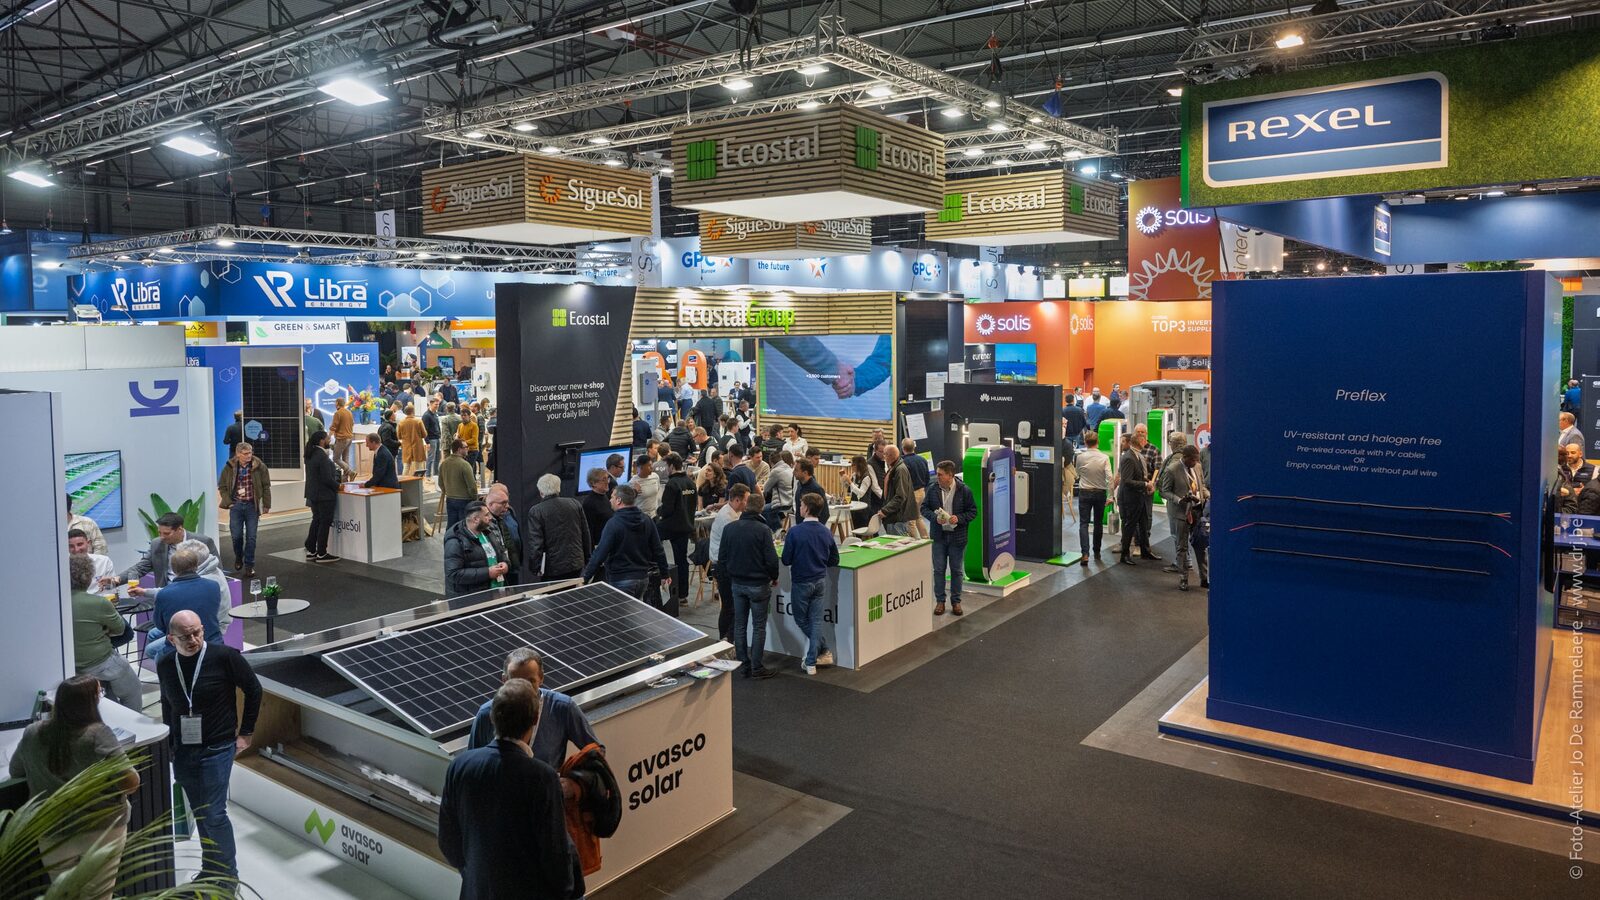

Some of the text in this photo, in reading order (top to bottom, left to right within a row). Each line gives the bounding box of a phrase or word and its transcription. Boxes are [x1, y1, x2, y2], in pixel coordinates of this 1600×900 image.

[721, 126, 820, 169] Ecostal
[880, 134, 939, 177] Ecostal
[449, 175, 513, 212] SigueSol
[567, 179, 643, 211] SigueSol
[967, 185, 1047, 216] Ecostal
[1084, 188, 1117, 215] Ecostal
[821, 217, 867, 239] SigueSol
[681, 252, 716, 268] GPC
[757, 261, 790, 271] the future
[911, 262, 932, 276] GPC
[130, 281, 160, 303] Libra
[304, 278, 368, 300] Libra
[274, 323, 303, 331] GREEN
[313, 322, 341, 331] SMART
[569, 311, 610, 326] Ecostal
[997, 314, 1032, 331] solis
[1080, 314, 1094, 330] solis
[1151, 320, 1186, 332] TOP3
[345, 352, 370, 362] Libra
[529, 384, 556, 393] Discover
[583, 381, 605, 390] e-shop
[1335, 388, 1388, 402] Preflex
[535, 394, 548, 402] and
[549, 393, 571, 402] design
[535, 399, 601, 412] Everything to simplify
[546, 413, 561, 422] your
[562, 411, 577, 420] daily
[1283, 430, 1442, 446] UV-resistant and halogen free
[1296, 445, 1334, 454] Pre-wired
[1335, 446, 1365, 456] conduit
[1366, 448, 1384, 457] with
[1398, 450, 1426, 459] cables
[1286, 460, 1310, 470] Empty
[1311, 462, 1341, 471] conduit
[1342, 463, 1360, 472] with
[1371, 466, 1401, 475] without
[1402, 467, 1418, 477] pull
[1419, 469, 1438, 477] wire
[886, 580, 924, 613] Ecostal
[776, 594, 838, 625] Ecal
[627, 732, 707, 783] avasco
[628, 767, 683, 811] solar
[341, 823, 383, 856] avasco
[341, 840, 370, 867] solar
